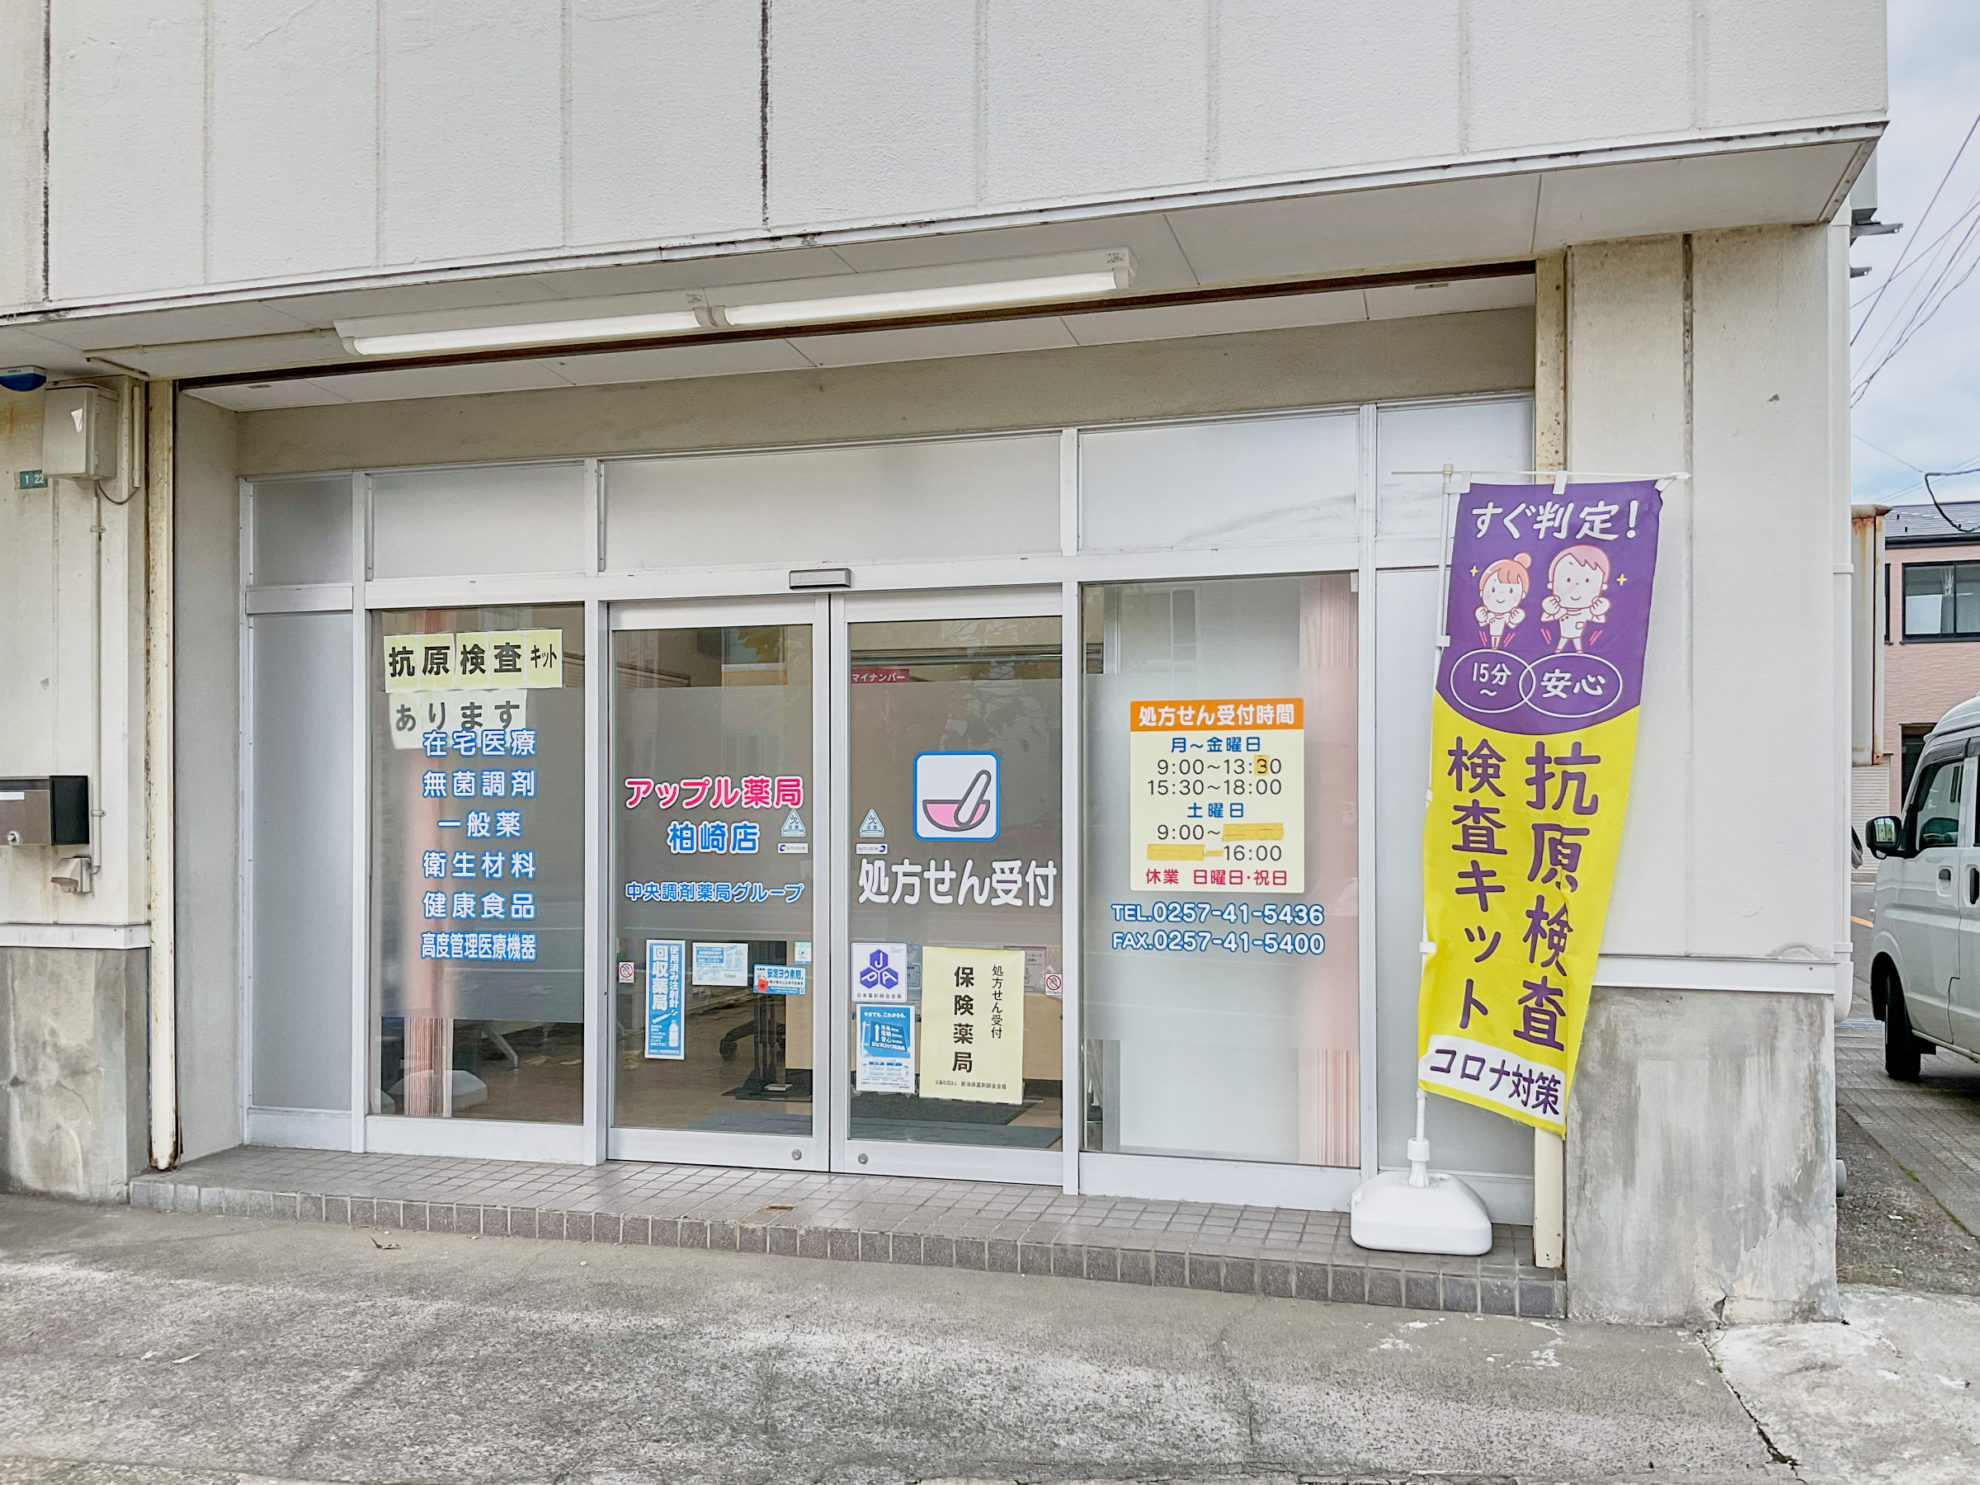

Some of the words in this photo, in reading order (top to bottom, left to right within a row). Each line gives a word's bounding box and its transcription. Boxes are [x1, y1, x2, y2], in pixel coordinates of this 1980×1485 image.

[1472, 500, 1639, 541] すぐ判定！
[851, 672, 905, 682] マイナンバー
[1541, 669, 1606, 698] 安心
[396, 701, 520, 732] あります
[1138, 703, 1295, 726] 処方せん受付時間
[423, 730, 536, 756] 在宅医療
[423, 771, 536, 797] 無菌調剤
[625, 776, 803, 809] アップル薬局
[437, 811, 521, 838] 一般薬
[1187, 803, 1244, 818] 土曜日
[668, 821, 760, 854] 柏崎店
[423, 851, 536, 878] 衛生材料
[1223, 845, 1282, 861] 16:00
[858, 858, 1057, 907] 処方せん受付
[1146, 869, 1179, 885] 休業
[1447, 736, 1507, 1029] 検査キット
[423, 892, 536, 919] 健康食品
[626, 881, 804, 903] 中央調剤薬局グループ
[1513, 741, 1601, 1052] 抗原検査
[1111, 901, 1324, 925] TEL.0257-41-5436
[421, 932, 536, 961] 高度管理医療機器
[1112, 930, 1325, 954] FAX.0257-41-5400
[652, 944, 668, 1011] 回収薬局
[991, 964, 1004, 1039] 処方せん受付
[952, 966, 975, 1073] 保険薬局
[1429, 1048, 1562, 1115] コロナ対策
